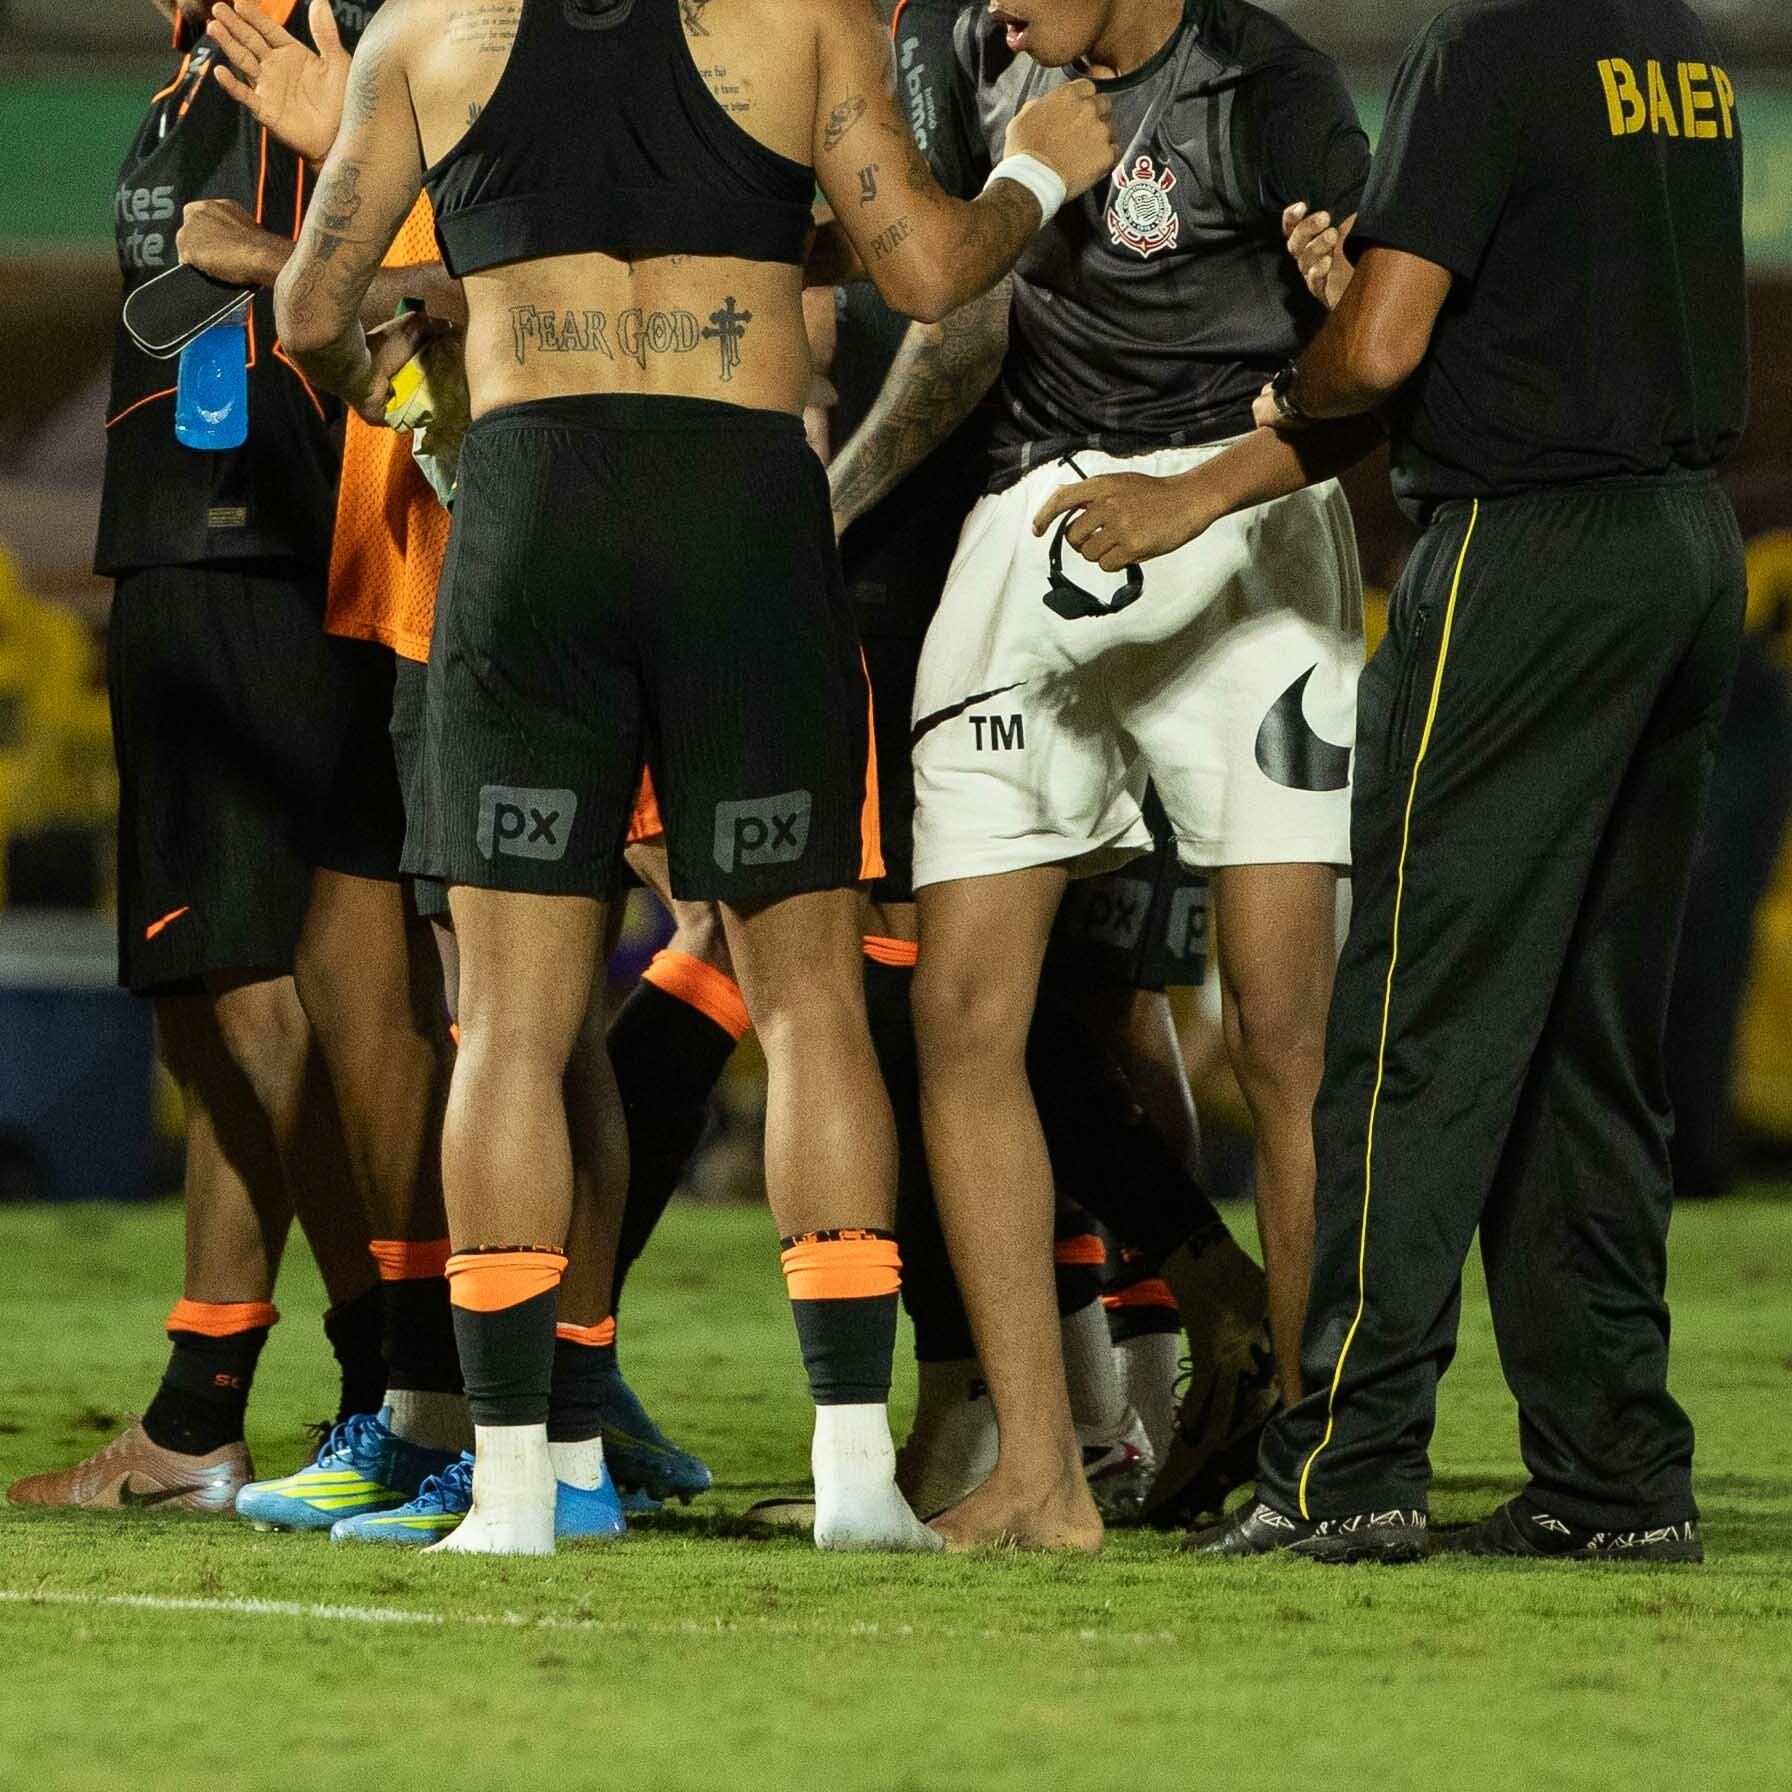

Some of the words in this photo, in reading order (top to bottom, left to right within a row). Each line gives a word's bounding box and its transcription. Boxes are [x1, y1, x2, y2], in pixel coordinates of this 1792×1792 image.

[924, 87, 937, 129] banco
[509, 305, 615, 366] FEAR
[616, 308, 700, 370] GOD
[968, 713, 1025, 751] TM
[492, 802, 561, 858] px
[731, 811, 802, 870] px
